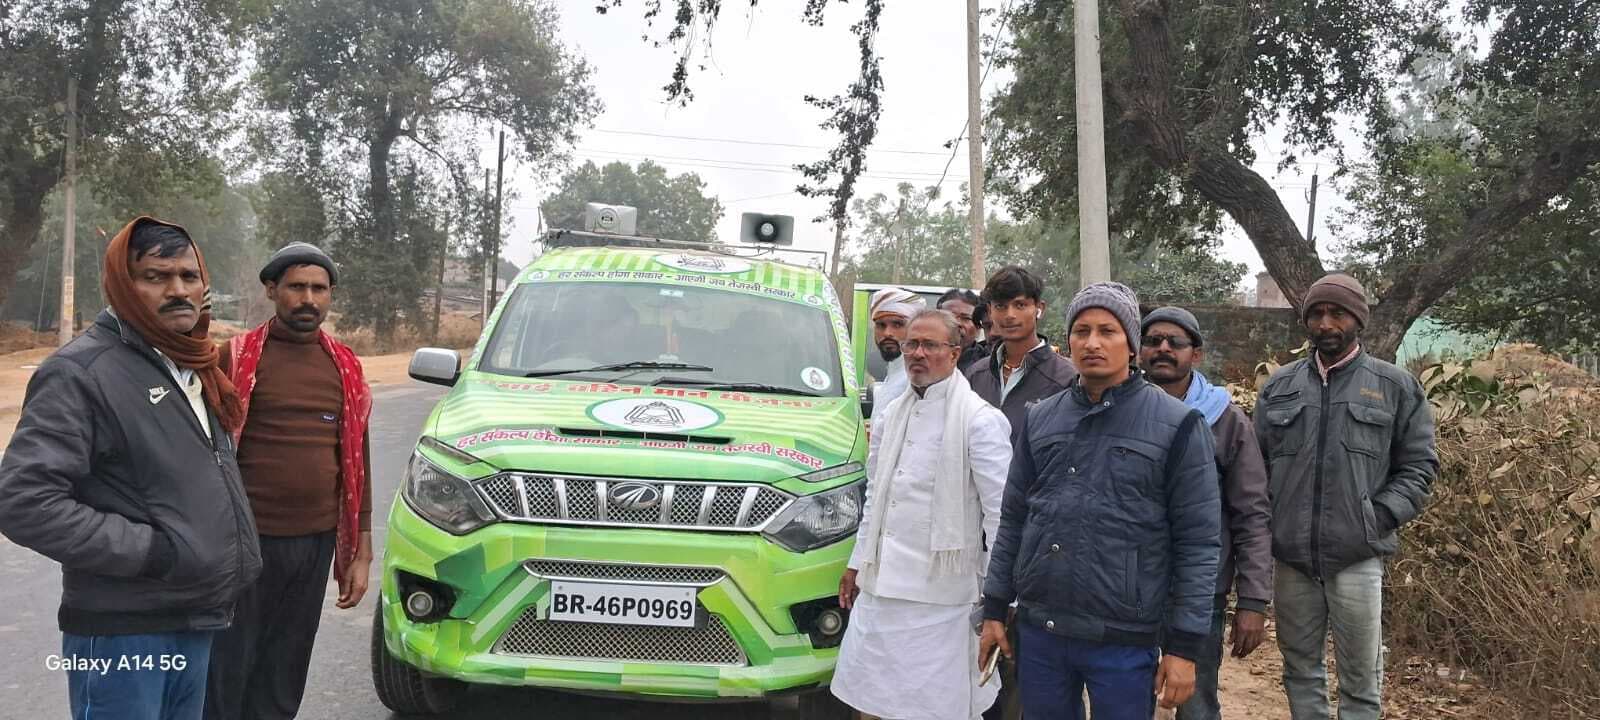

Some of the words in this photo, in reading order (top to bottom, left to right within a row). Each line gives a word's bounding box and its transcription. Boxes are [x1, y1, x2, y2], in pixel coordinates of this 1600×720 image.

[608, 270, 630, 279] होगा
[633, 271, 664, 280] साकार
[764, 286, 796, 299] सरकार
[456, 434, 477, 449] हर
[480, 428, 530, 443] संकल्प
[775, 447, 825, 470] सरकार
[553, 593, 693, 620] BR-46P0969
